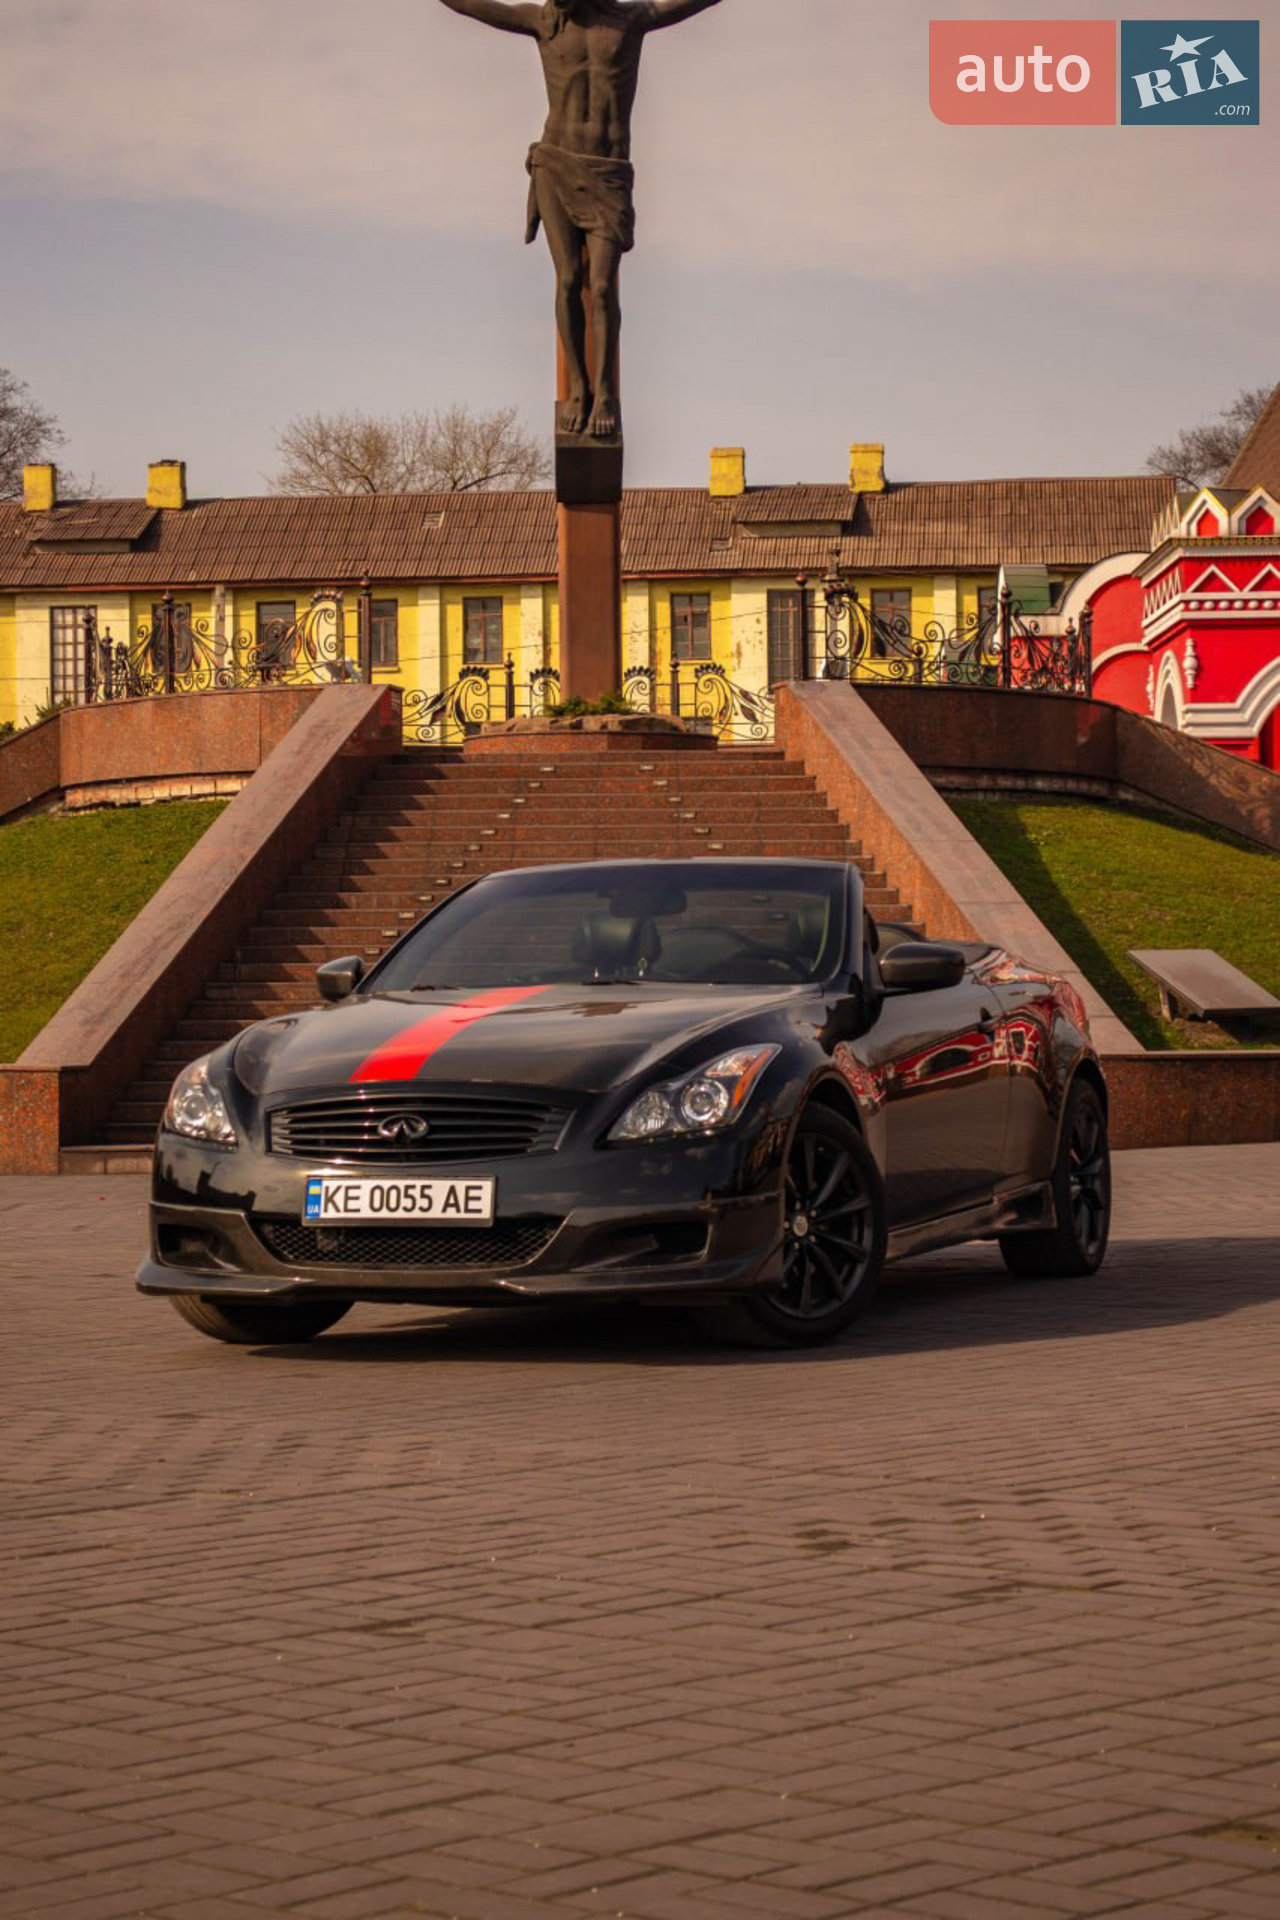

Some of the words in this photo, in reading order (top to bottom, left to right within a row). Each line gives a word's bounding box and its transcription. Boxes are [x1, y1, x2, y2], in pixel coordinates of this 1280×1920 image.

[323, 1185, 361, 1213] KE
[369, 1184, 433, 1213] 0055
[441, 1185, 483, 1213] AE
[307, 1204, 320, 1214] UA
